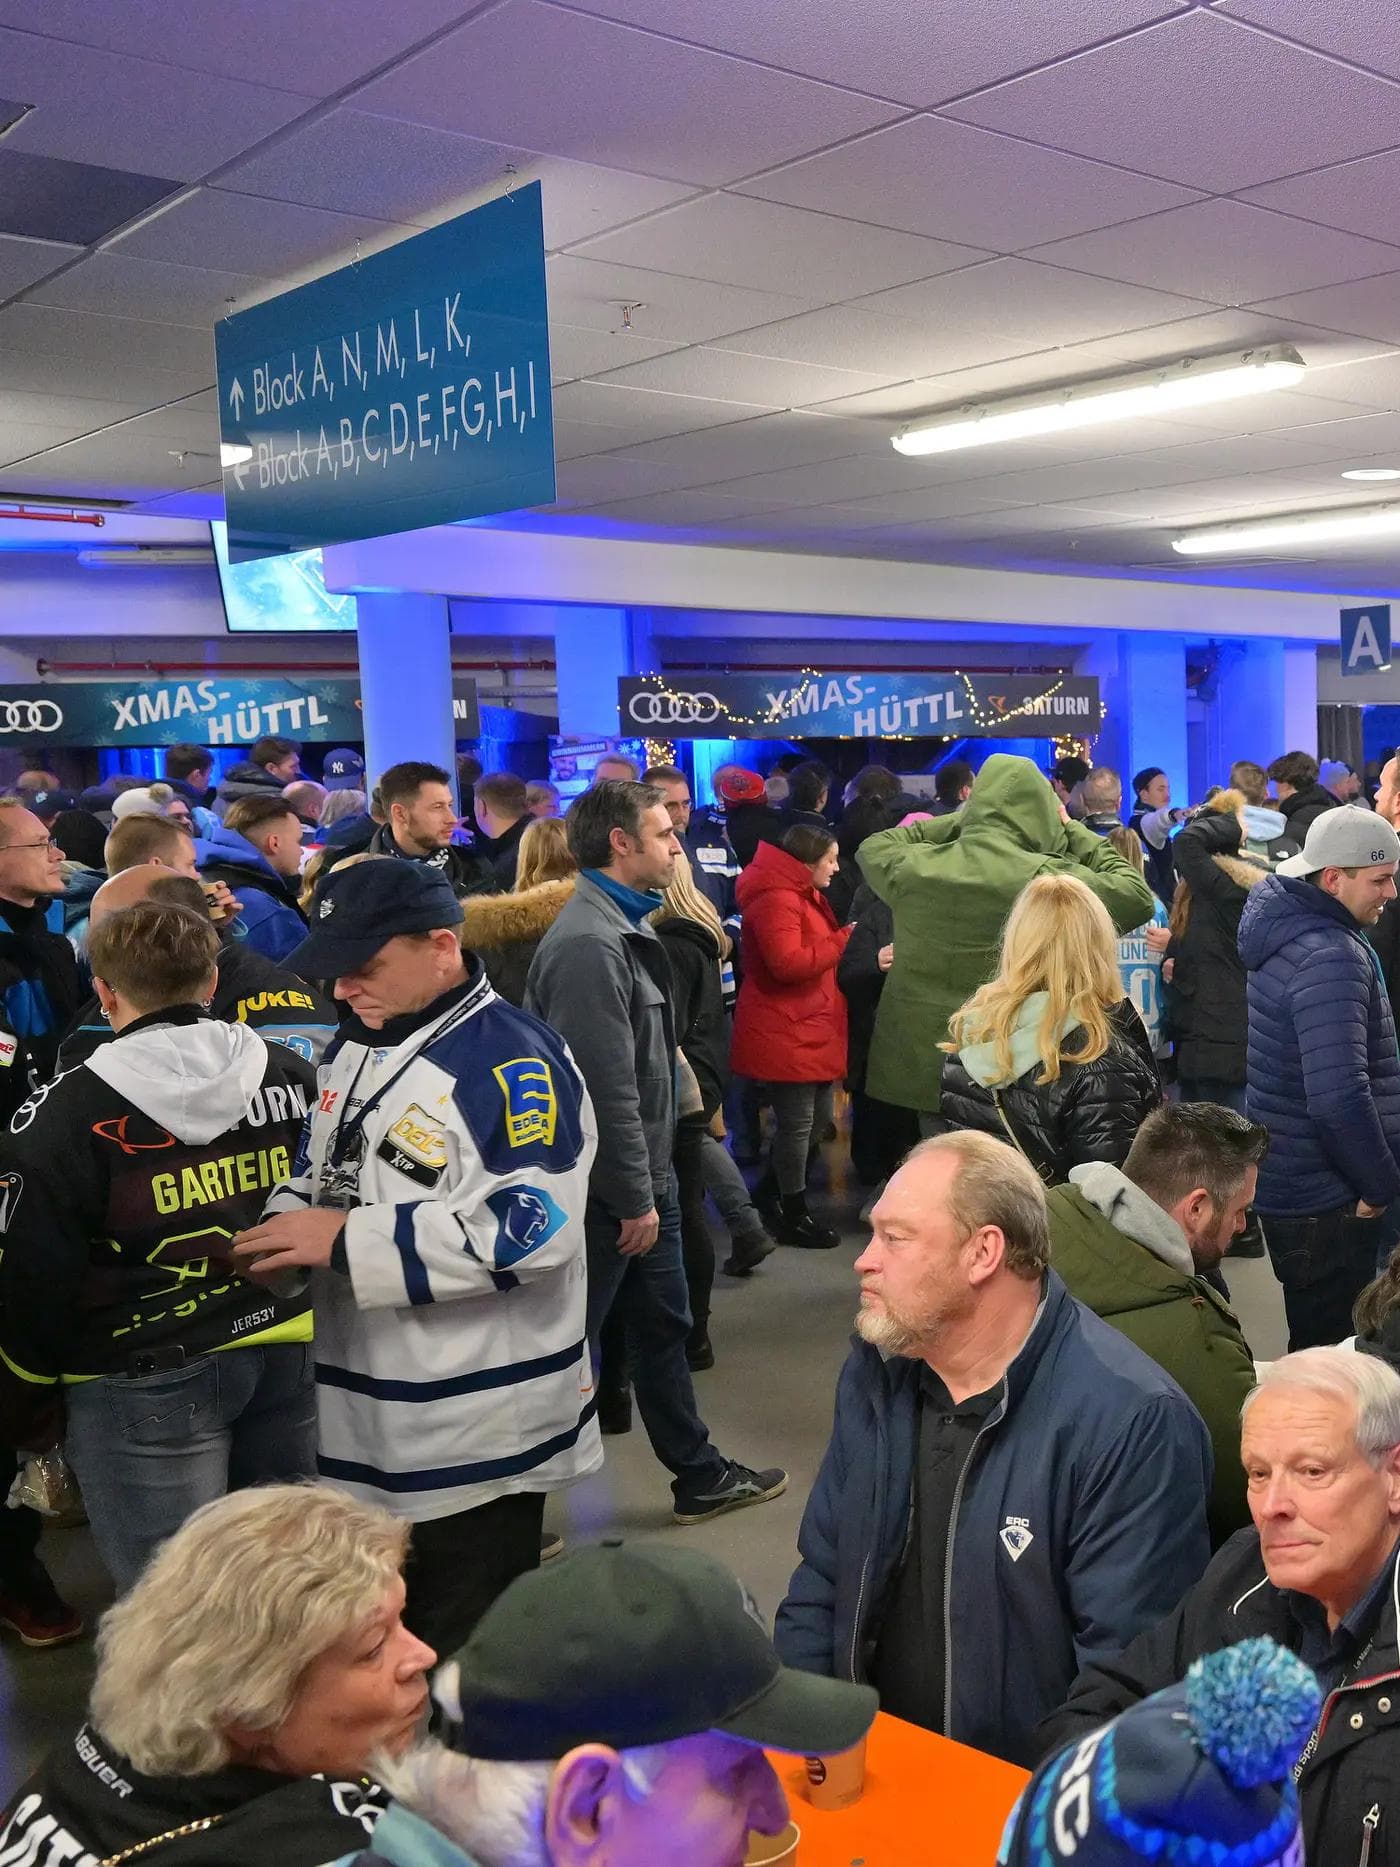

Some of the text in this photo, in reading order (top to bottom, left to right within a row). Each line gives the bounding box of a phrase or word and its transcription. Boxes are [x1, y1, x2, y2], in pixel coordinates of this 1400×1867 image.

[253, 292, 471, 416] Block A, N, M, L, K,
[257, 429, 311, 489] Block
[1347, 616, 1384, 667] A
[111, 680, 231, 731] XMAS-
[208, 695, 329, 744] HÜTTL
[765, 676, 876, 721] XMAS-
[854, 690, 964, 737] HÜTTL
[1022, 696, 1089, 716] SATURN
[1371, 849, 1385, 861] 66
[237, 990, 316, 1023] JUKE!
[235, 1083, 309, 1131] URN
[512, 1114, 549, 1131] EDEA
[152, 1145, 291, 1215] GARTEIG
